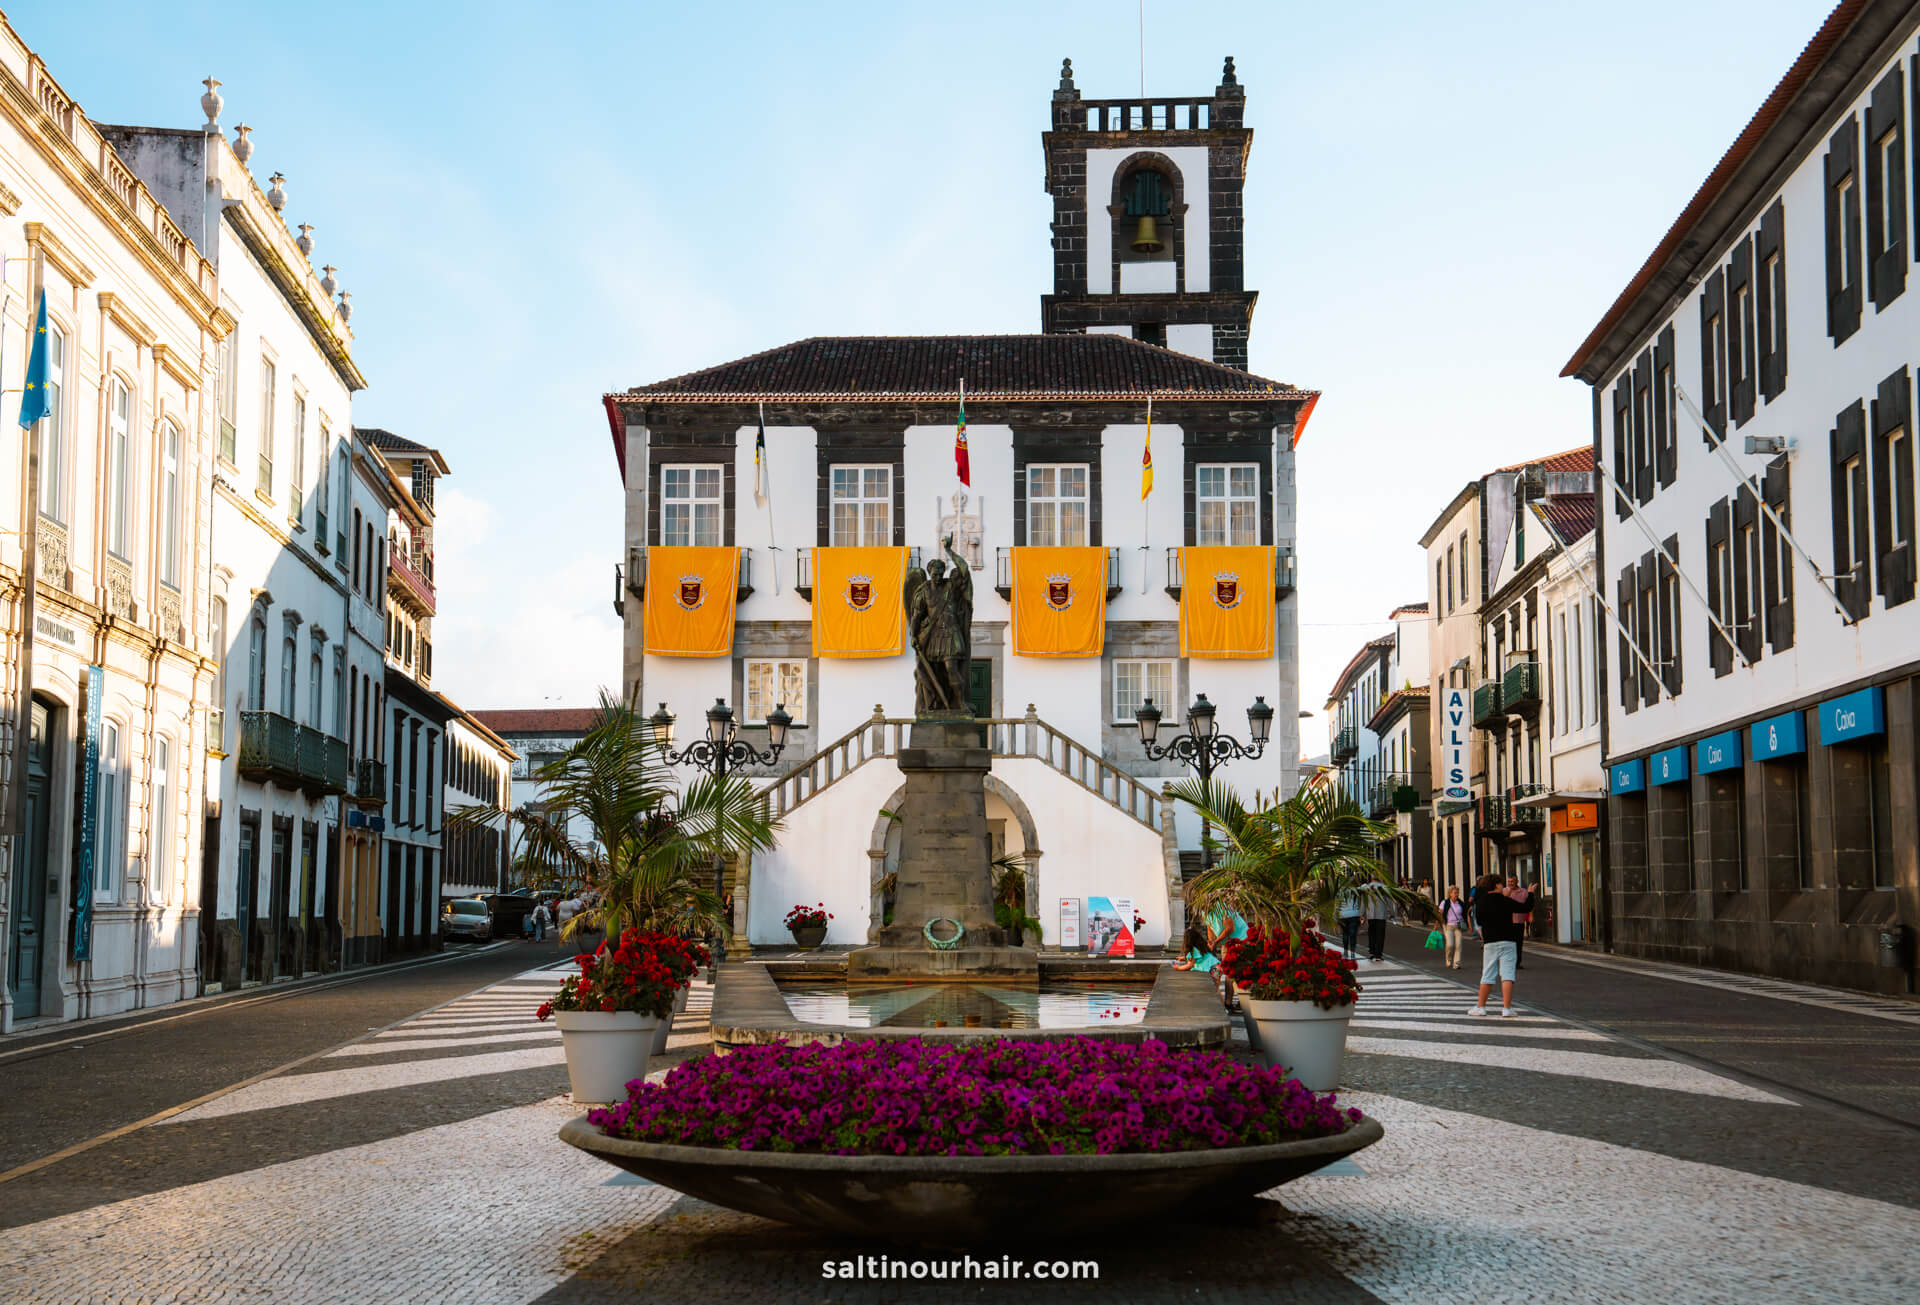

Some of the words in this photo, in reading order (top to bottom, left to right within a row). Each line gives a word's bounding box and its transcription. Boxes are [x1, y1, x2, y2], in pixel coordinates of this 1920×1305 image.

[1835, 708, 1856, 731] Caixa
[1449, 691, 1464, 784] AVLIS
[1708, 745, 1722, 765] Caixa
